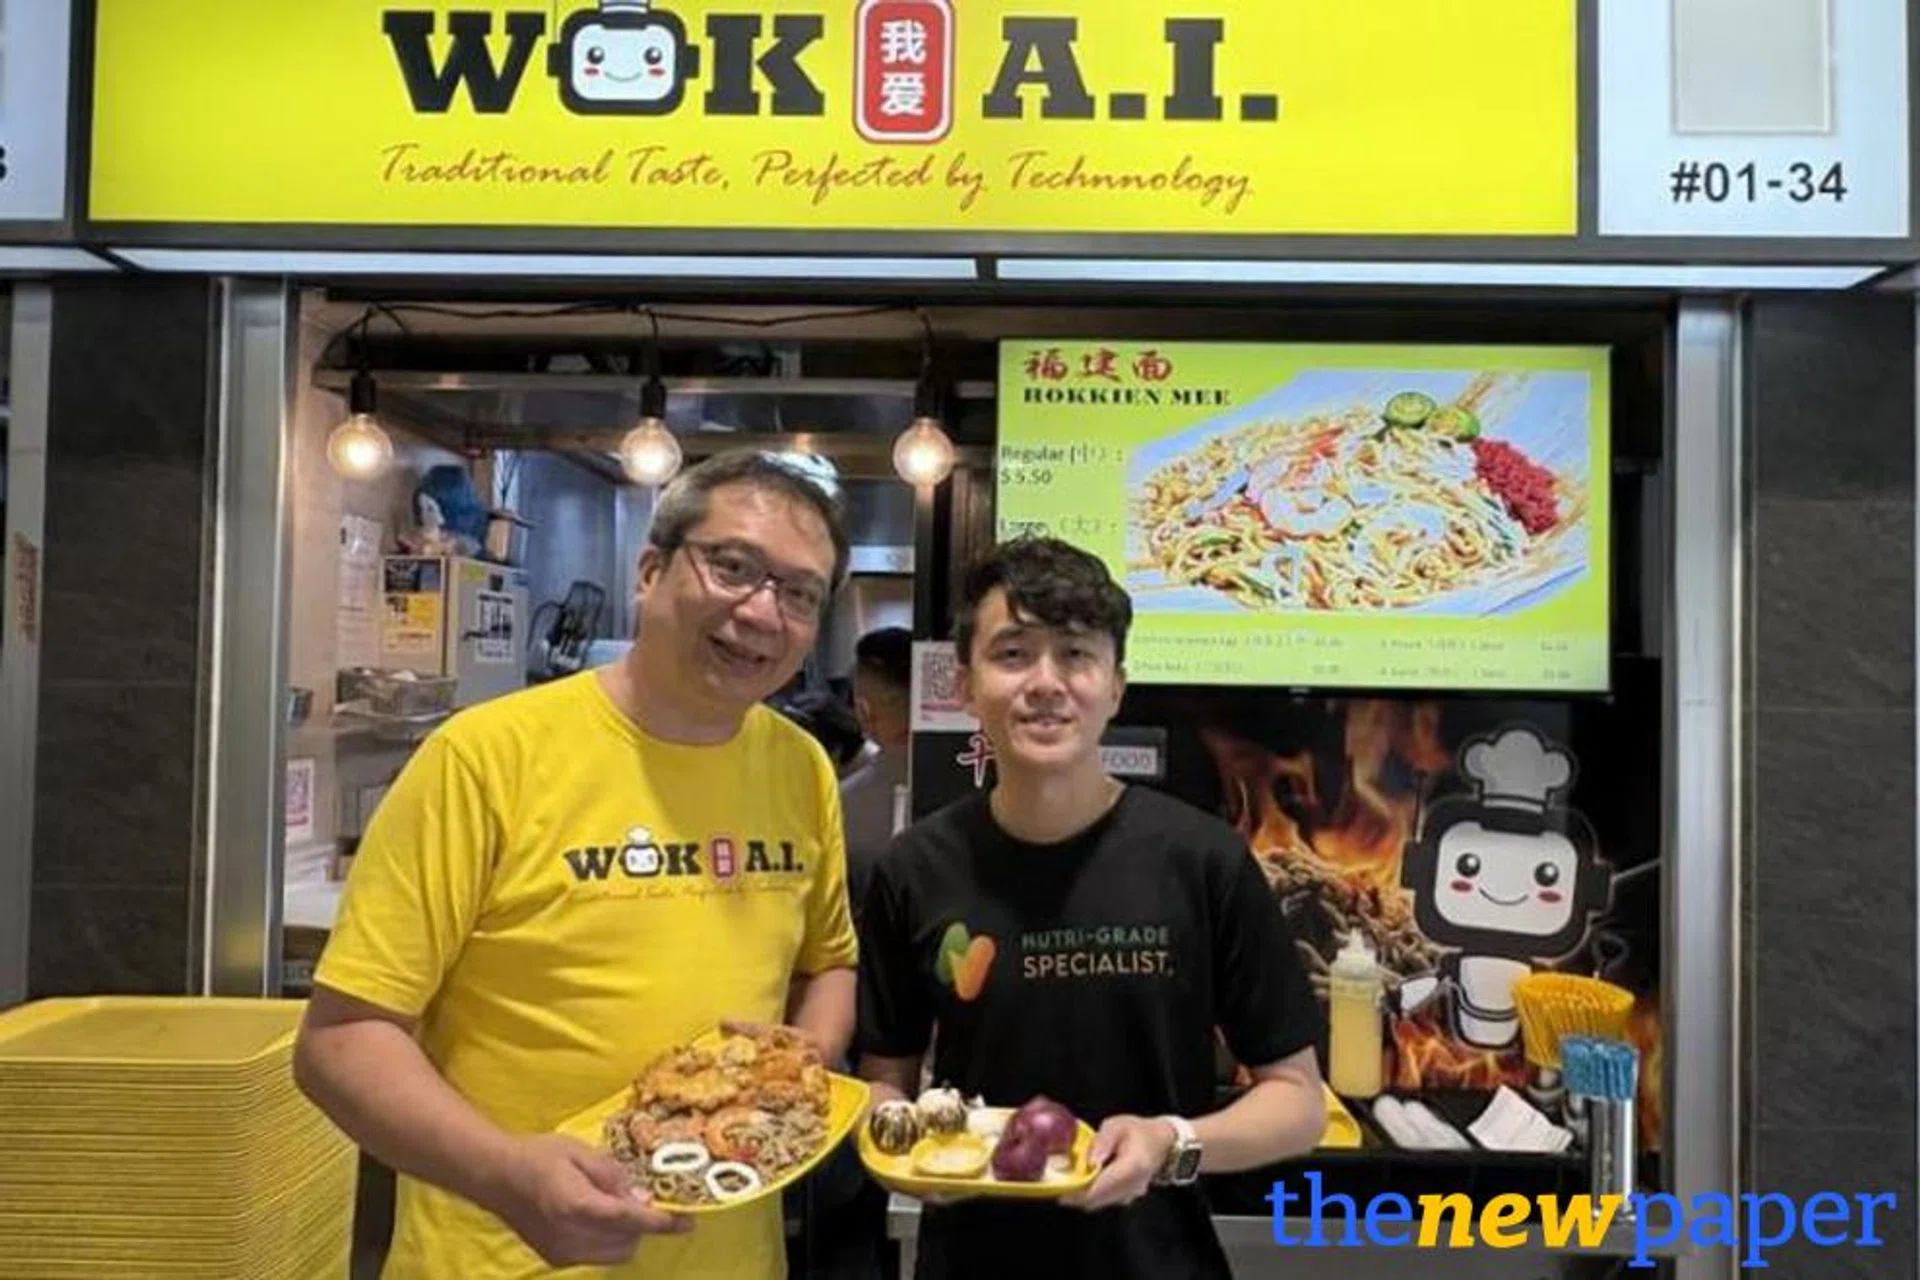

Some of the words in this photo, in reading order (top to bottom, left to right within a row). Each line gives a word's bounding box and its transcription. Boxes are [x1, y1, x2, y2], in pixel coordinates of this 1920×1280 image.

[879, 20, 927, 117] 我爱
[982, 17, 1279, 121] A.I.
[380, 143, 612, 186] Traditional
[627, 147, 730, 190] Taste,
[753, 149, 933, 205] Perfected
[945, 151, 984, 212] by
[1669, 162, 1849, 204] #01-34
[1024, 348, 1173, 382] 福建面
[1023, 387, 1160, 404] HOKKIEN
[1171, 388, 1231, 405] MEE
[1001, 446, 1064, 465] Regular
[745, 841, 804, 873] A.I.
[1021, 927, 1169, 951] NUTRI-GRADE
